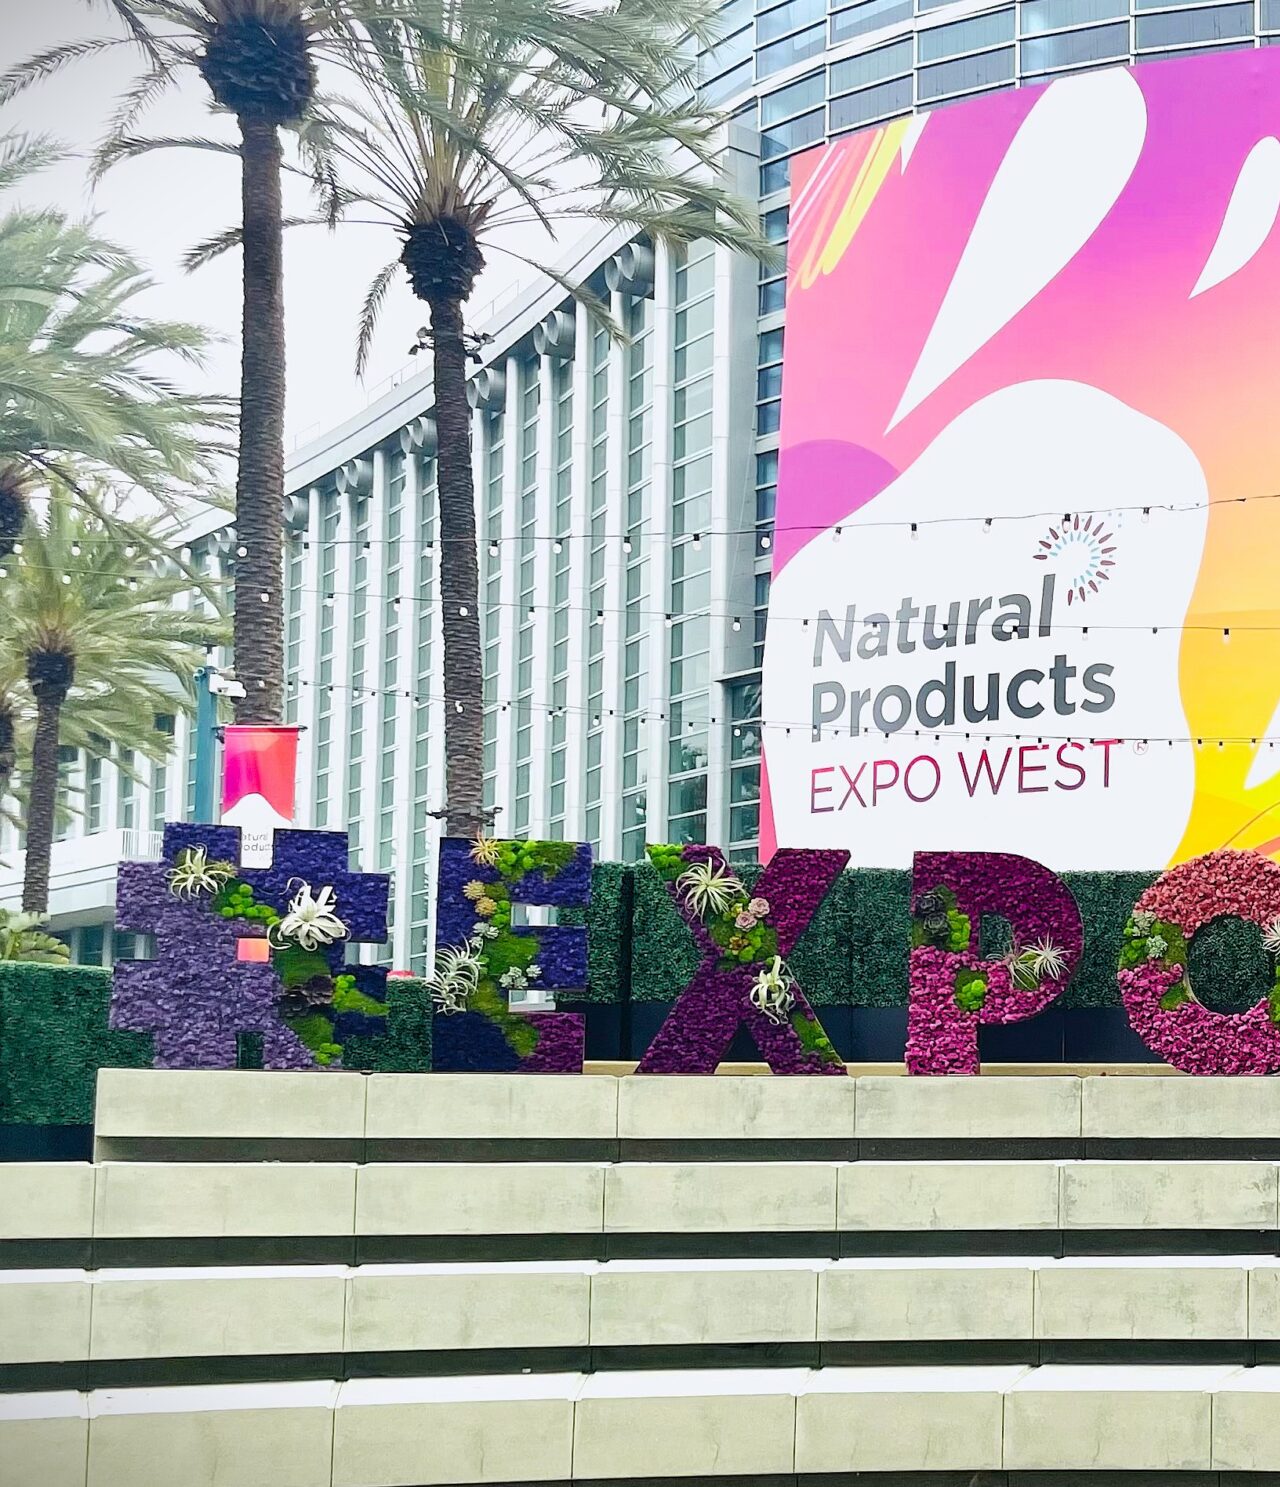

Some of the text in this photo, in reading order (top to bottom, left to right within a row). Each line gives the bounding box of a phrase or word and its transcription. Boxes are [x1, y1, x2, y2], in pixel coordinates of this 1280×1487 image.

[812, 573, 1056, 667] Natural
[811, 654, 1116, 743] Products
[810, 738, 1123, 814] EXPO WEST
